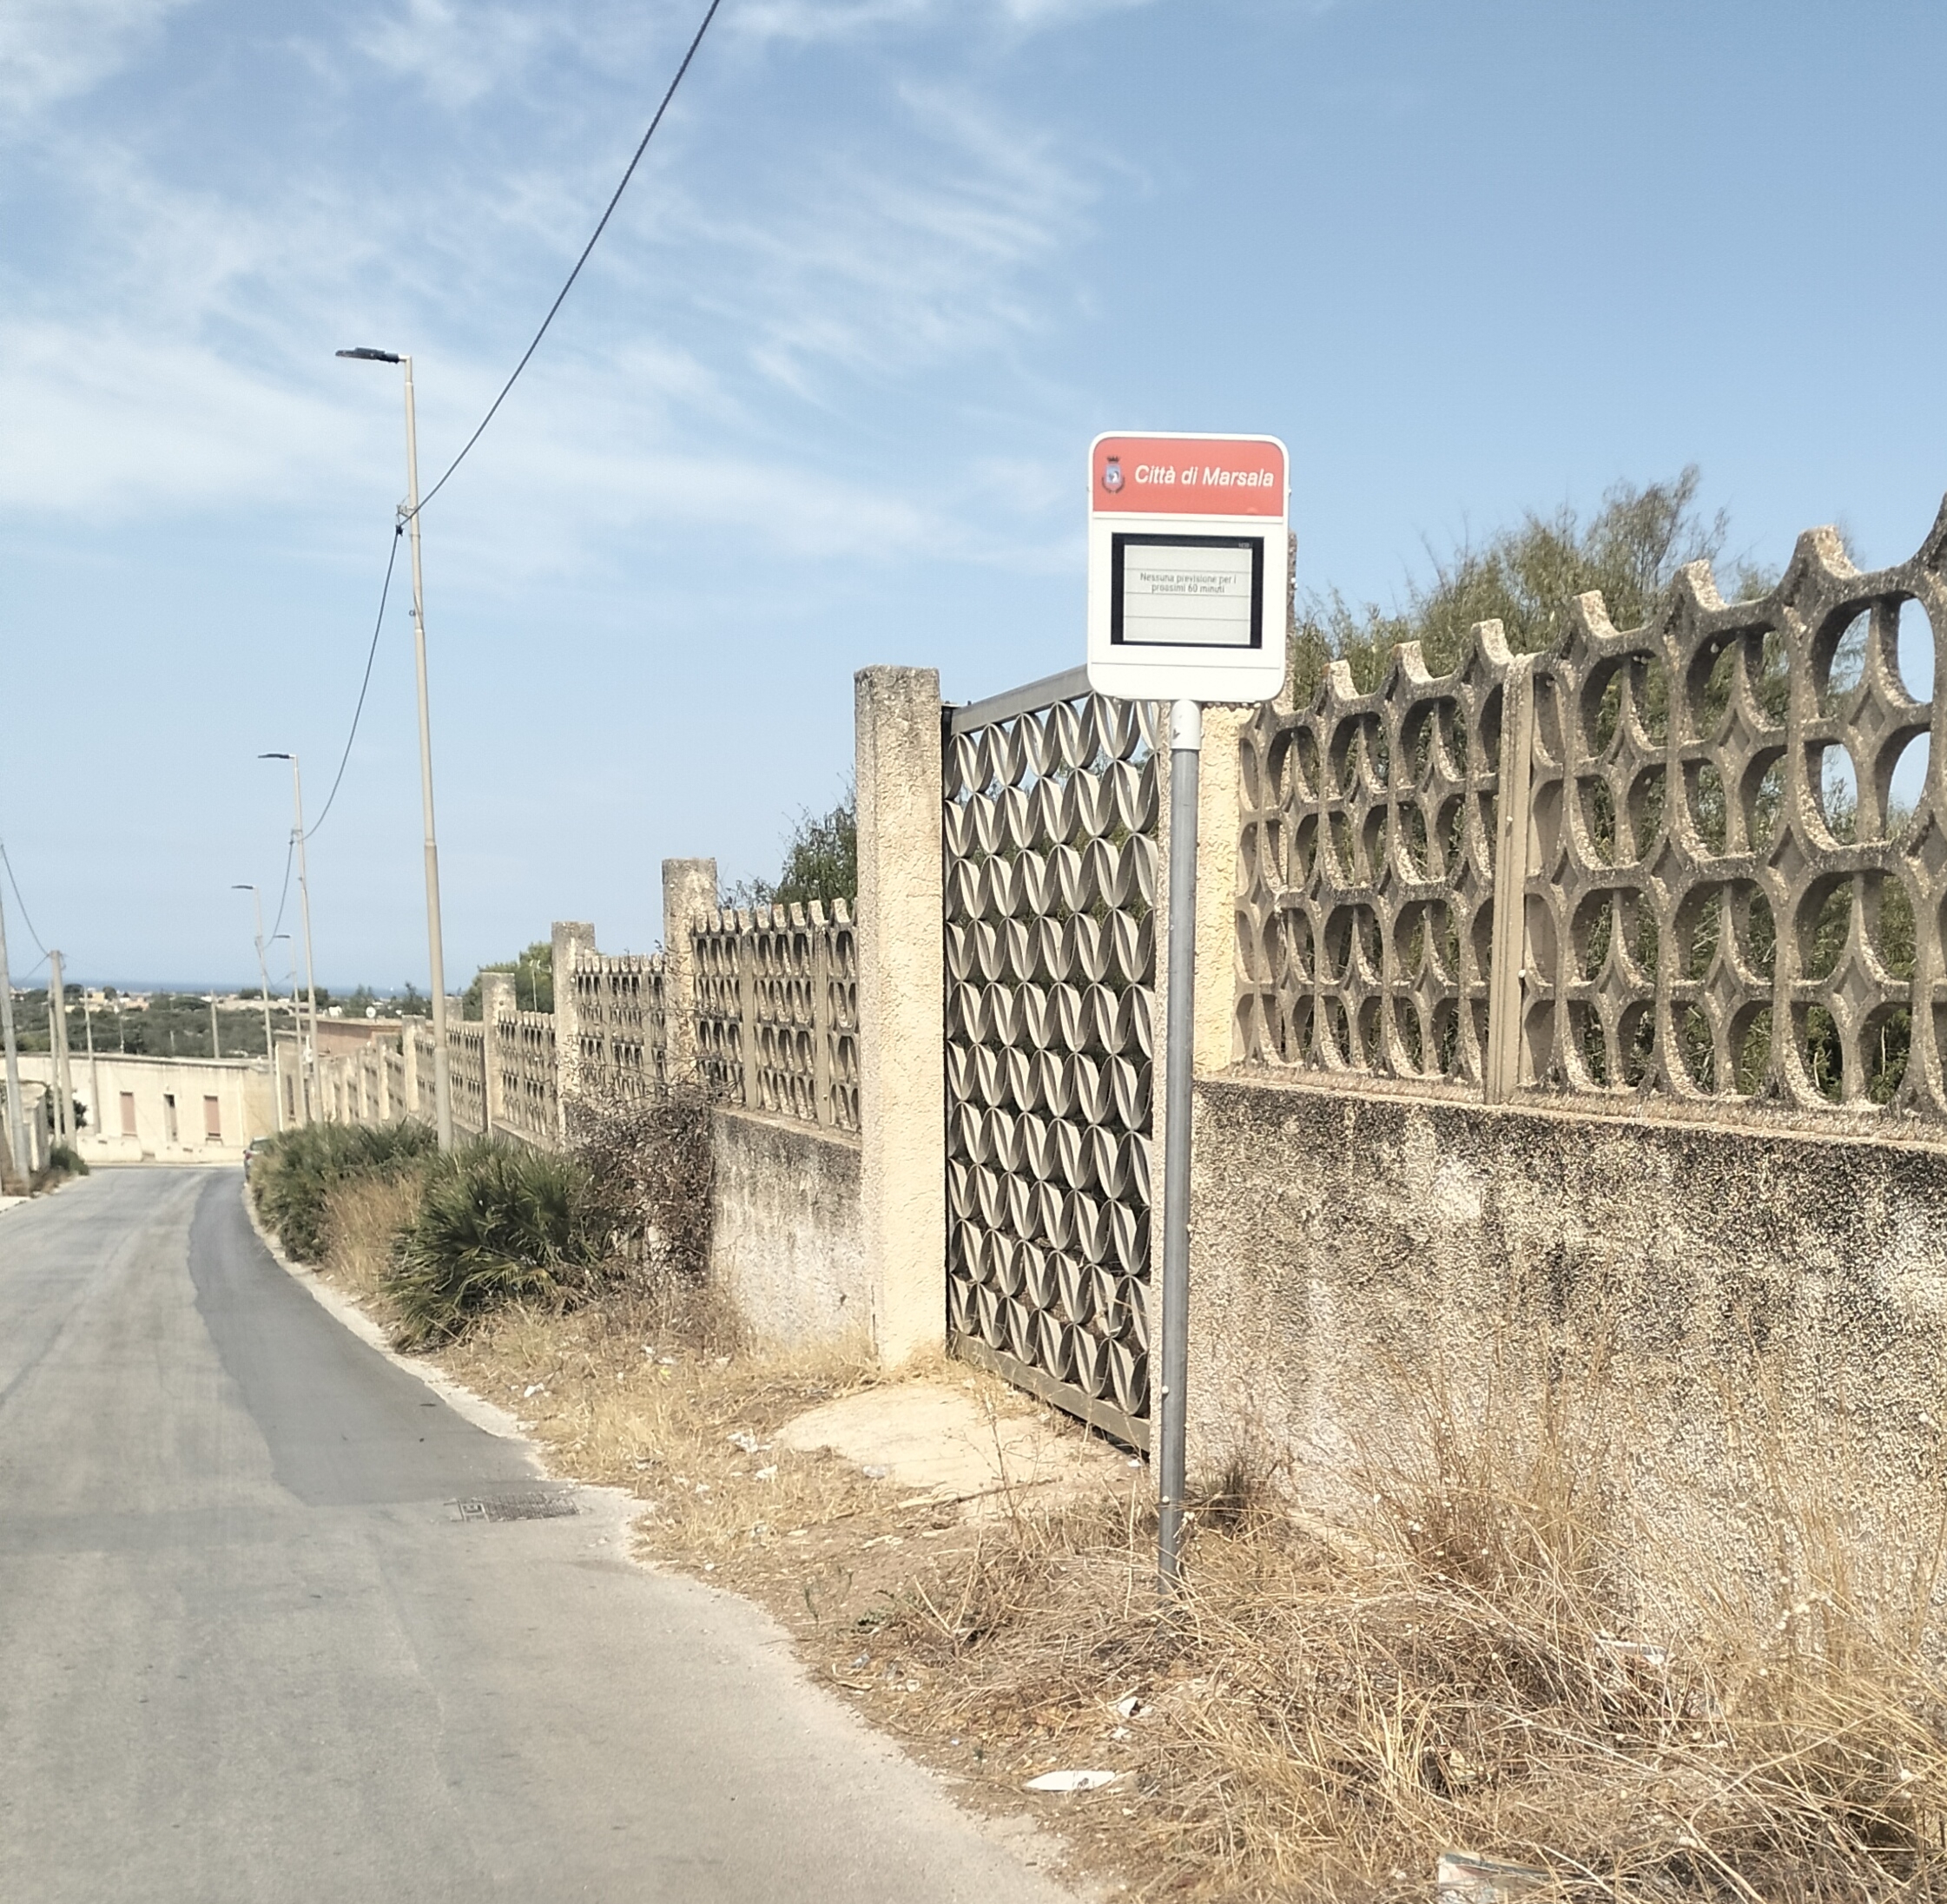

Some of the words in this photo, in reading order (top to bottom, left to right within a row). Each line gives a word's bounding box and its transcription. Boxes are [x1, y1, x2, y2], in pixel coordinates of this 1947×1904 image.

[1134, 464, 1175, 484] Città
[1181, 467, 1198, 485] di
[1203, 467, 1274, 487] Marsala
[1140, 572, 1174, 583] Nessuna
[1176, 574, 1216, 583] previsione
[1188, 584, 1198, 593] 60
